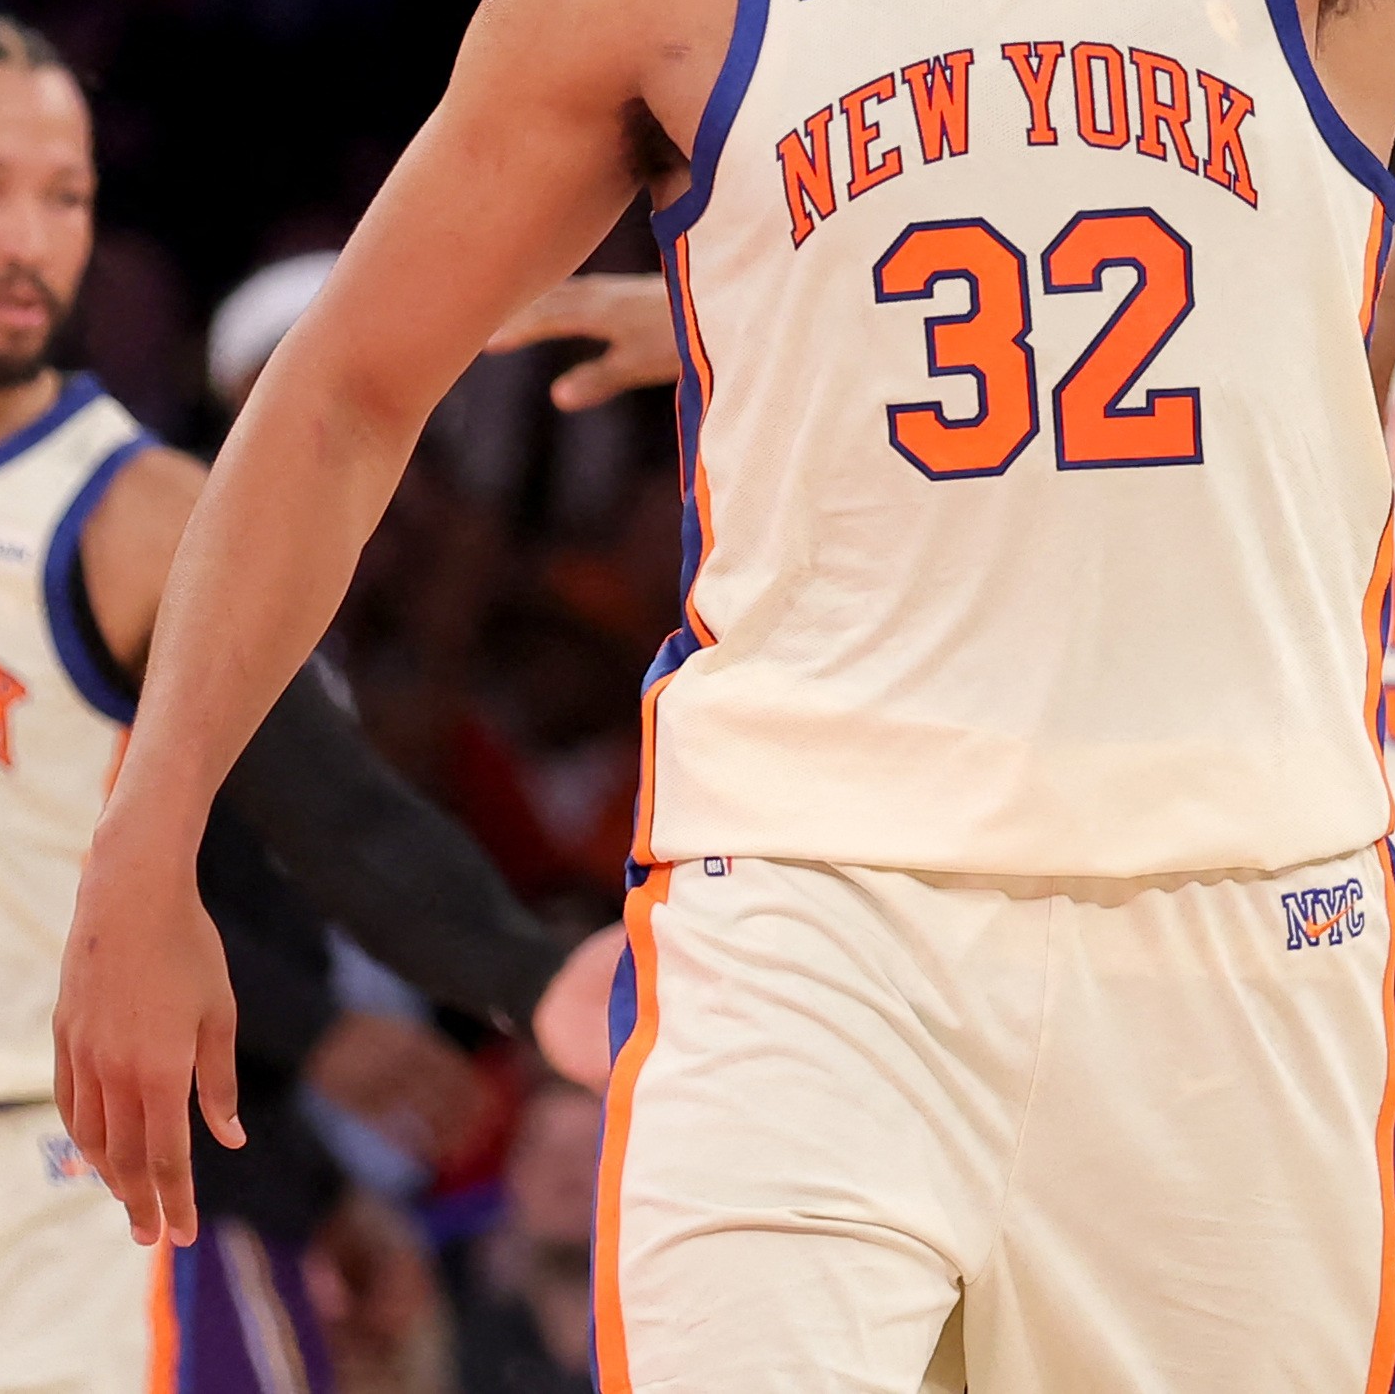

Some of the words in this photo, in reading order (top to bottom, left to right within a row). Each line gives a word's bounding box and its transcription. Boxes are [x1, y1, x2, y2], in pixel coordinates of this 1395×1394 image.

[775, 49, 974, 249] NEW
[1001, 41, 1258, 211] YORK
[874, 207, 1204, 481] 32
[1281, 878, 1364, 950] NYC
